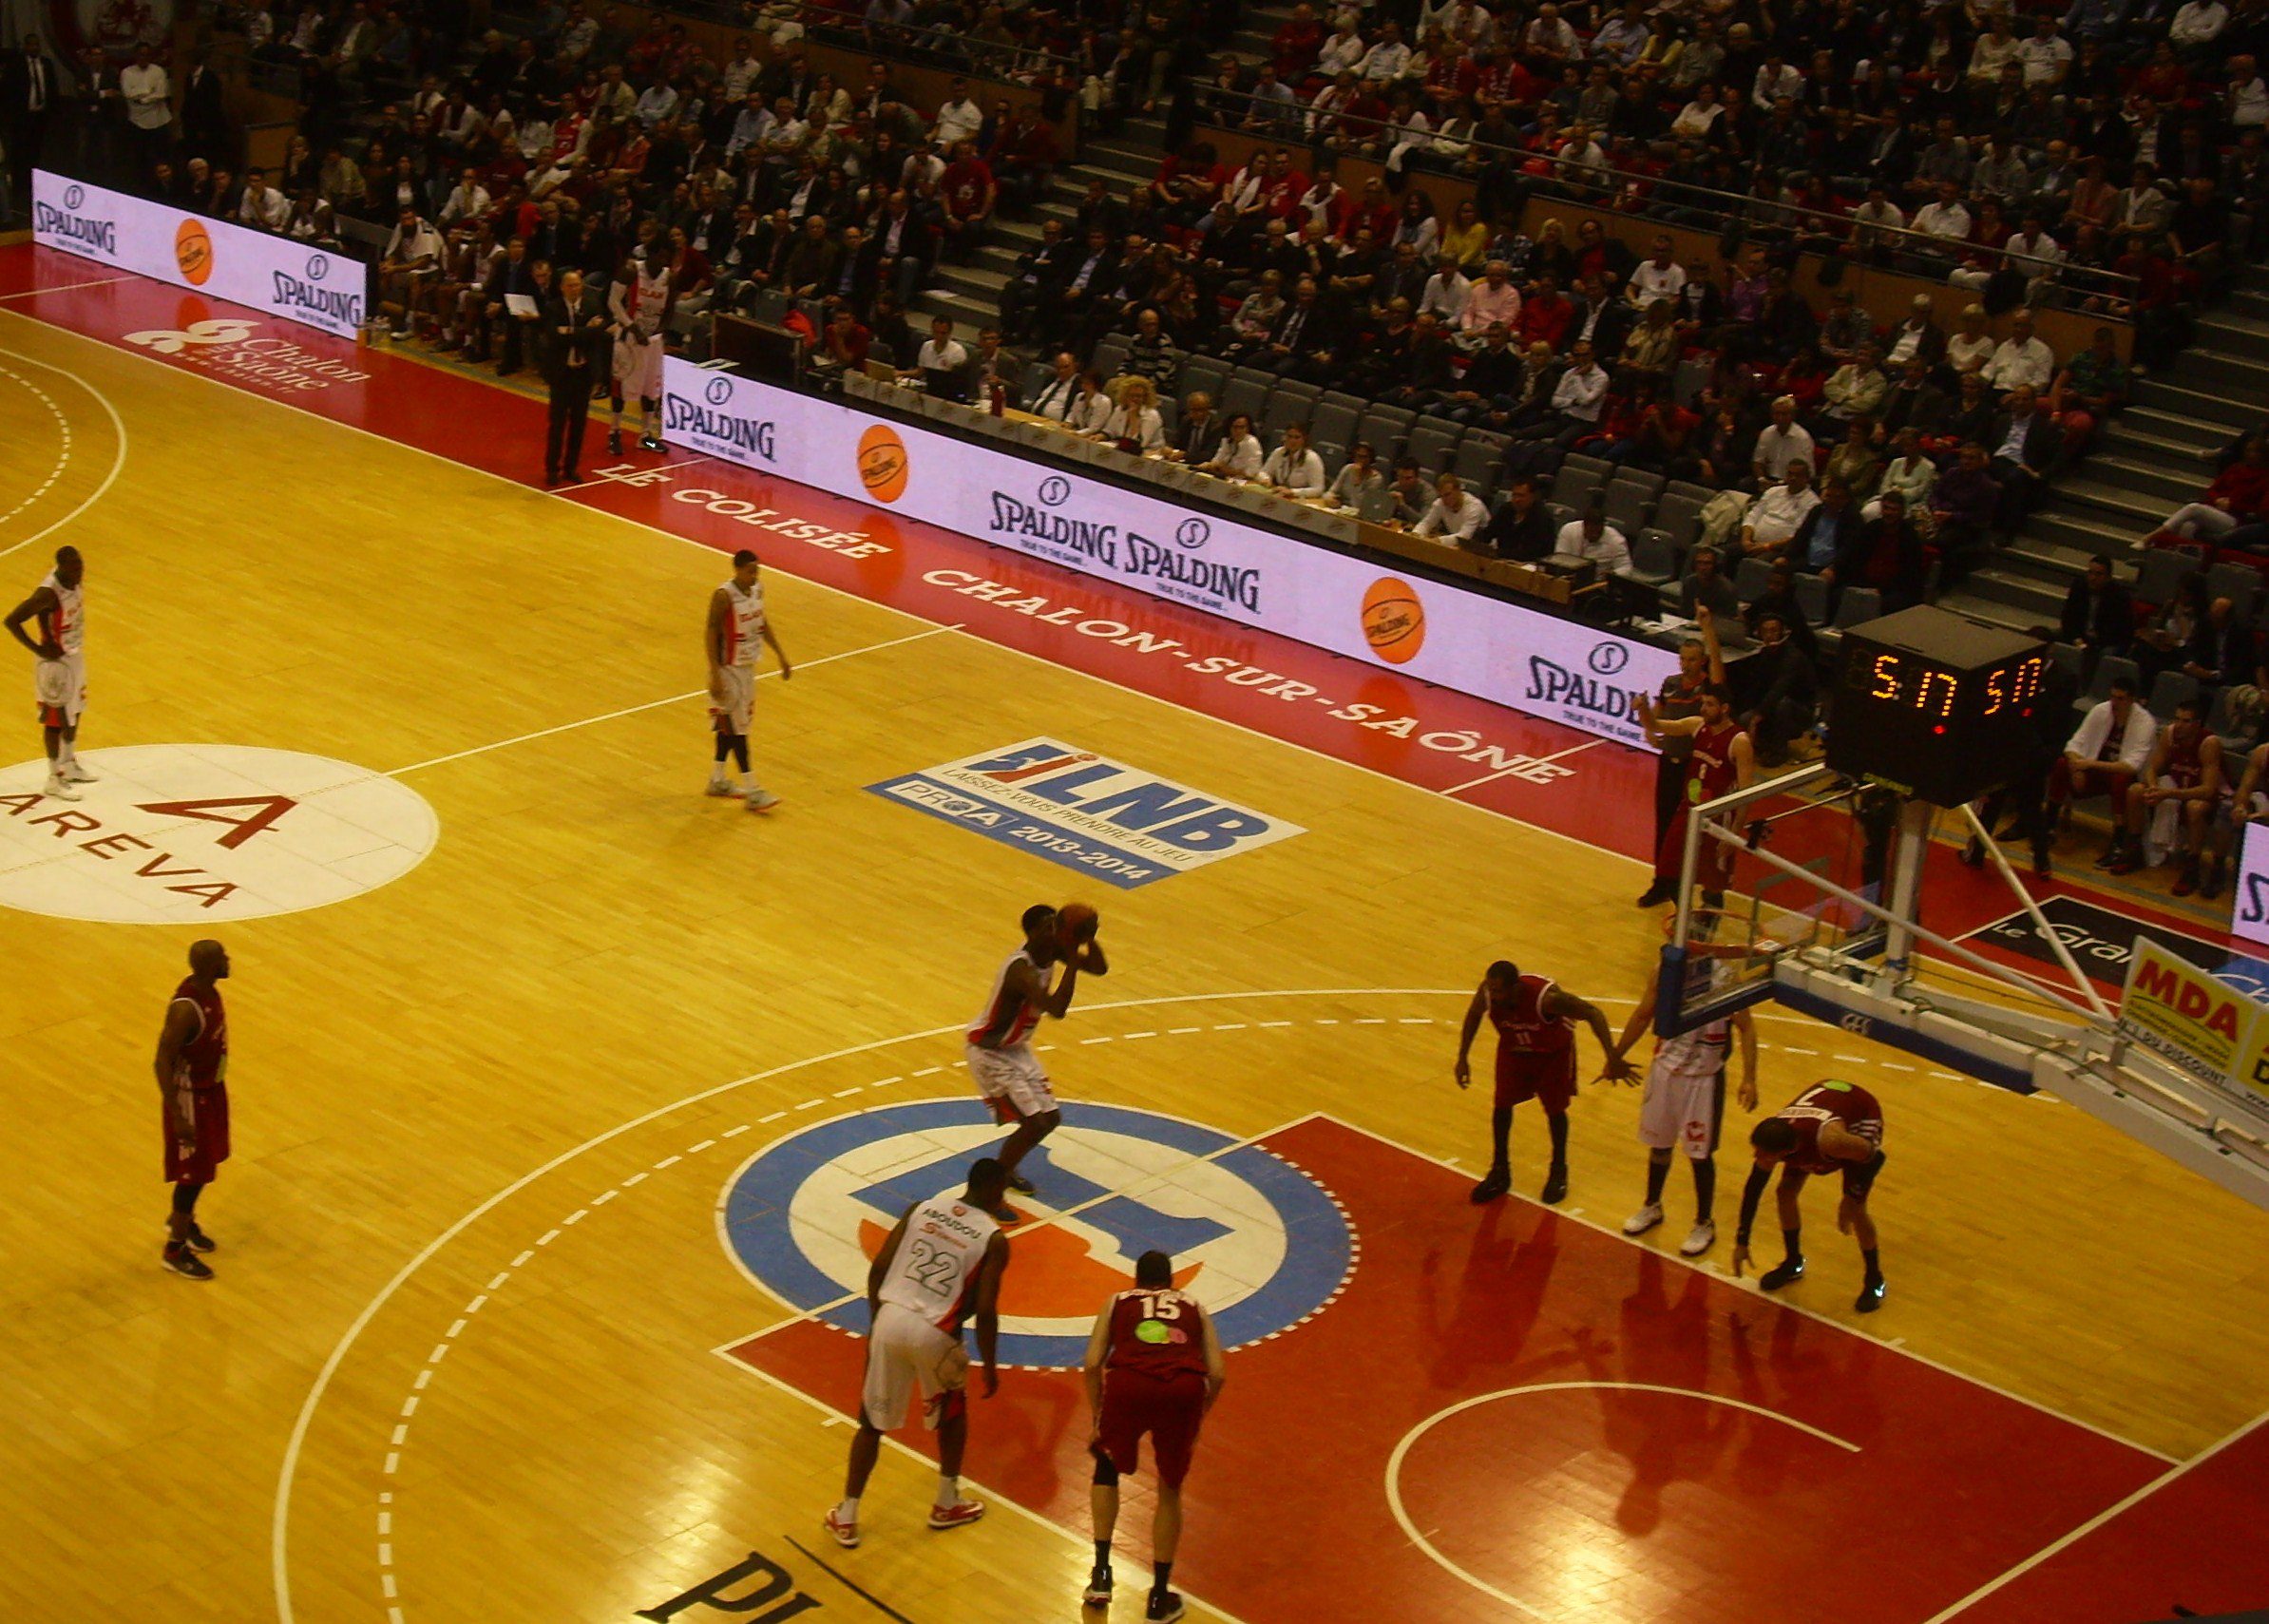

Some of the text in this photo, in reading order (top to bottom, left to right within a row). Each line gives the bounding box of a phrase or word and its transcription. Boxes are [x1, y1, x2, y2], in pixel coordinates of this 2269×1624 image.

[36, 200, 117, 257] SPALDING
[272, 270, 363, 328] SPALDING
[241, 338, 372, 383] Chalon
[666, 392, 777, 463] SPALDING
[592, 464, 893, 559] LE COLISÉE
[989, 490, 1117, 567] SPALDING
[1124, 532, 1261, 614] SPALDING
[0, 793, 239, 908] AREVA
[1007, 826, 1153, 880] 2013-2014
[1053, 810, 1133, 841] PRENDRE
[1127, 838, 1158, 850] AU
[1154, 849, 1194, 862] JEU
[2135, 959, 2240, 1043] MDA
[904, 1238, 960, 1298] 22
[1139, 1292, 1181, 1320] 15
